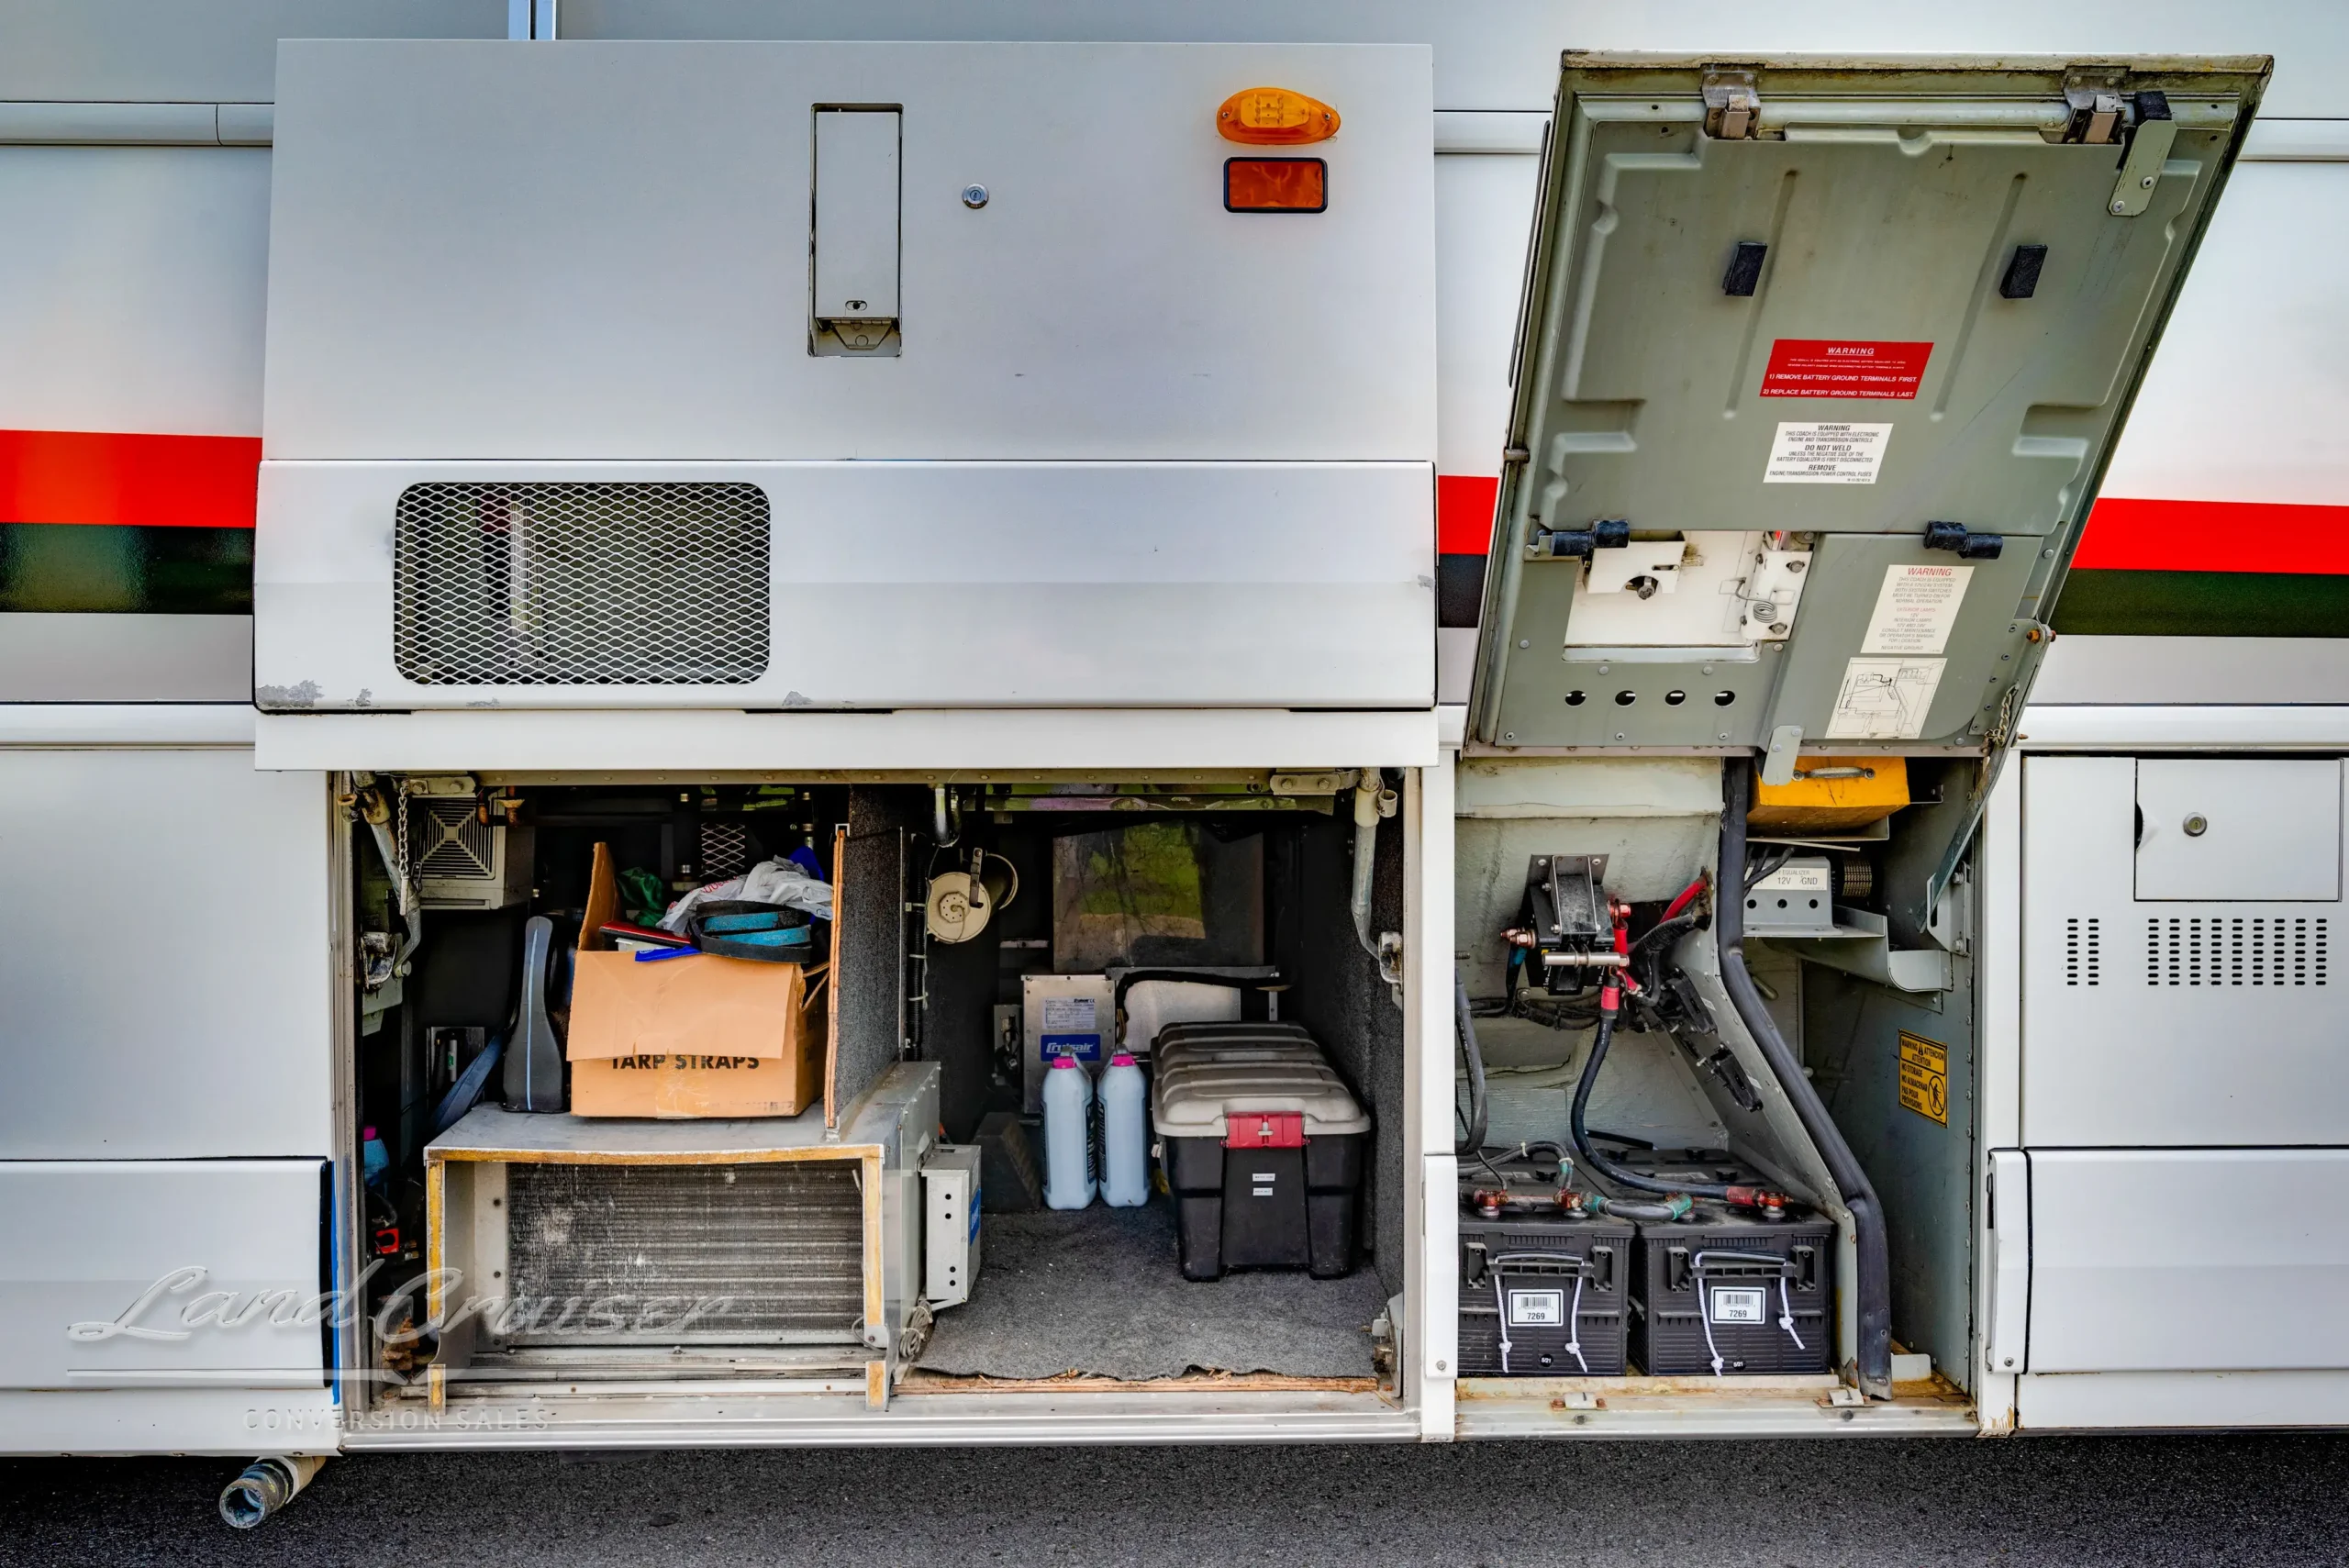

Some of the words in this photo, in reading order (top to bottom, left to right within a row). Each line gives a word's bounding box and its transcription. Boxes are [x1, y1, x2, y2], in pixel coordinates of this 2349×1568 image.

[1828, 347, 1874, 355] WARNING
[1908, 567, 1952, 576] WARNING
[1046, 1042, 1093, 1053] Crusair
[675, 1055, 760, 1070] STRAPS
[1527, 1312, 1545, 1320] 7269
